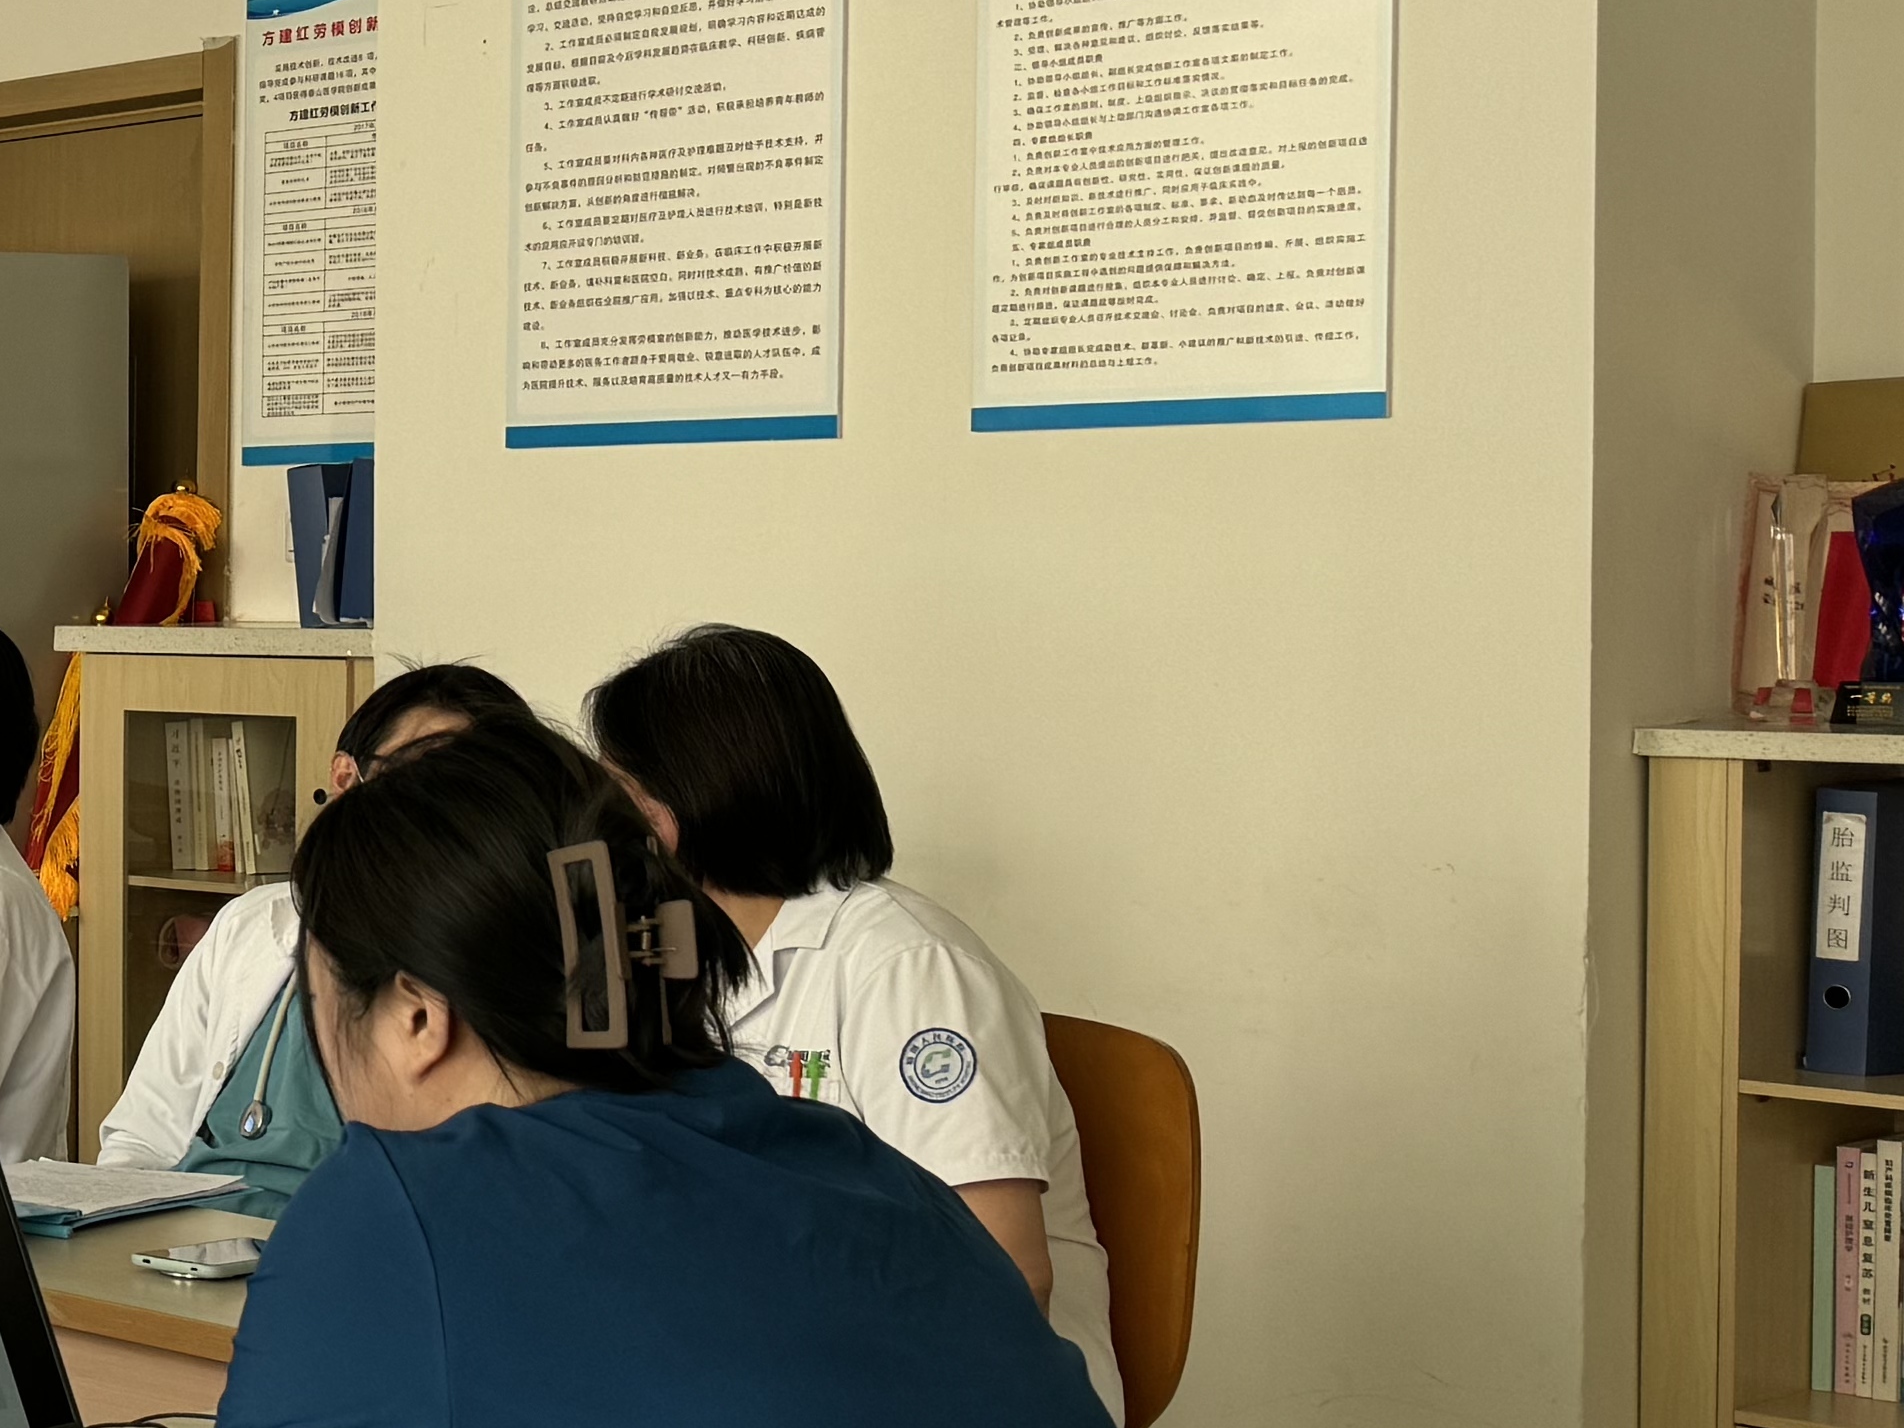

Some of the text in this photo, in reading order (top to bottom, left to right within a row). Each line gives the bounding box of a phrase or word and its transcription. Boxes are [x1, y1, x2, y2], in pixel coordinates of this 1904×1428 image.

[1827, 827, 1855, 950] 胎监判图
[1862, 1170, 1875, 1280] 新生儿窒息复苏
